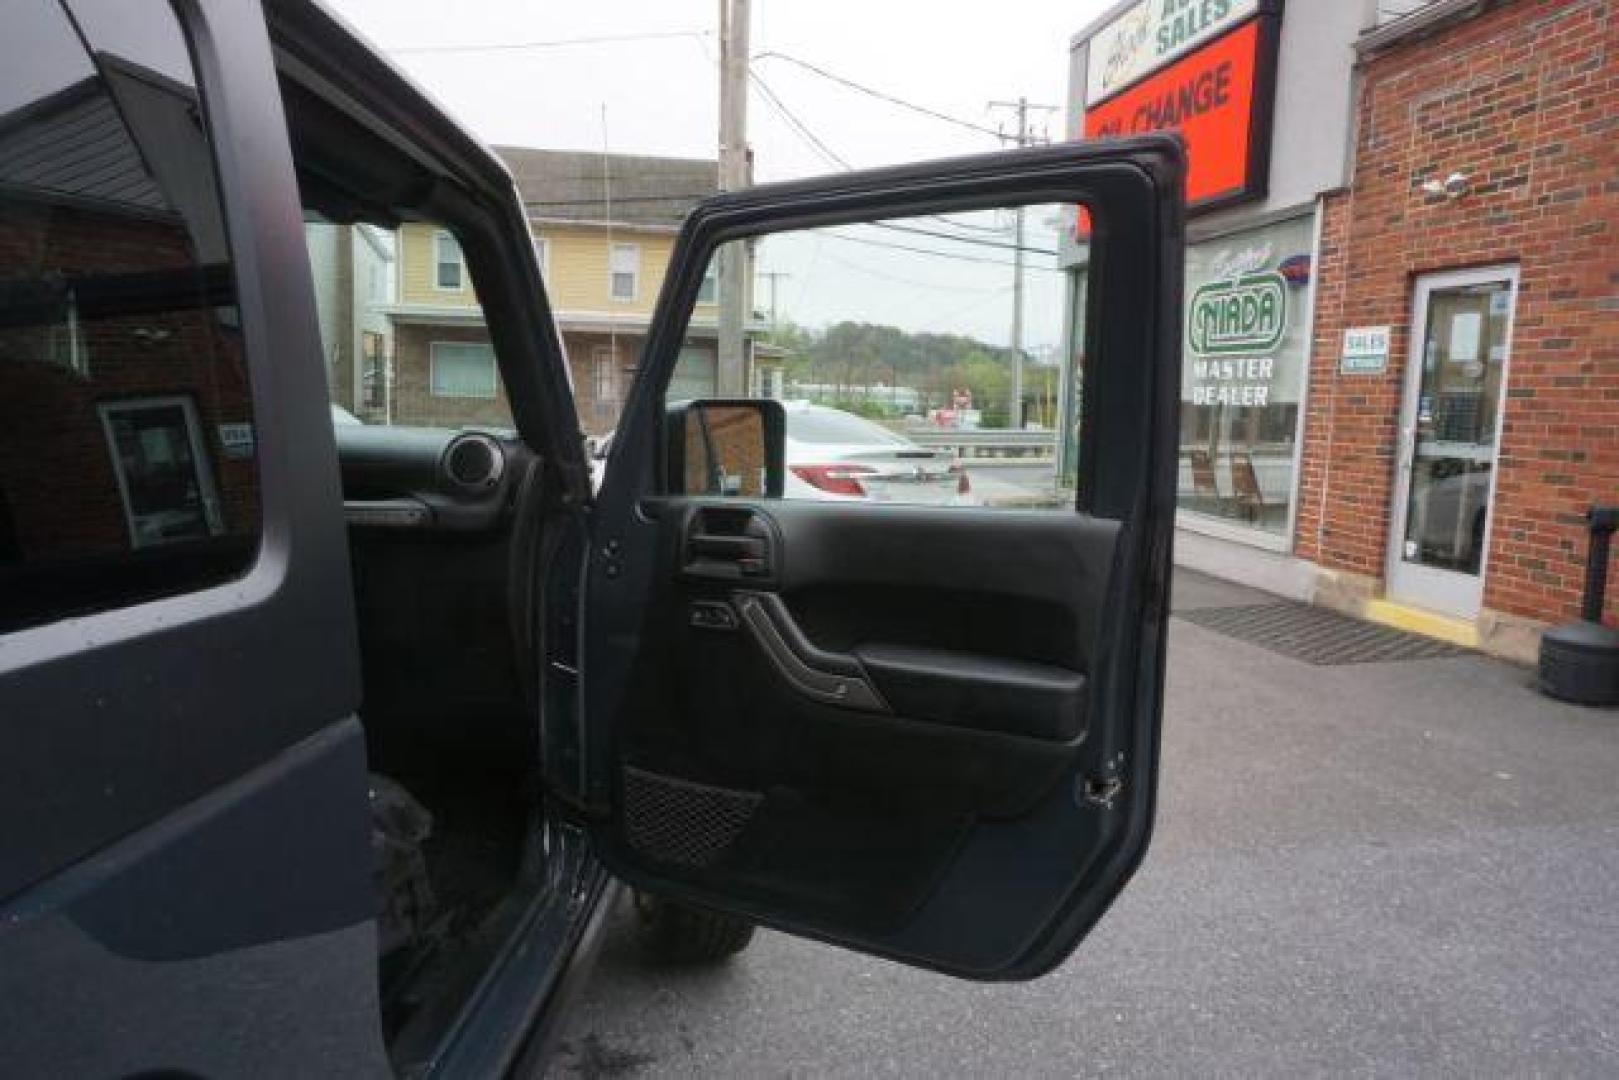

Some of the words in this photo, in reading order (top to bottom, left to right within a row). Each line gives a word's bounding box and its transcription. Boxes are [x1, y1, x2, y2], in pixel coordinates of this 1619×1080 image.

[1156, 0, 1229, 56] SALES
[1130, 61, 1233, 132] CHANGE
[1199, 292, 1275, 346] NIADA
[1193, 358, 1274, 379] MASTER
[1193, 386, 1269, 406] DEALER
